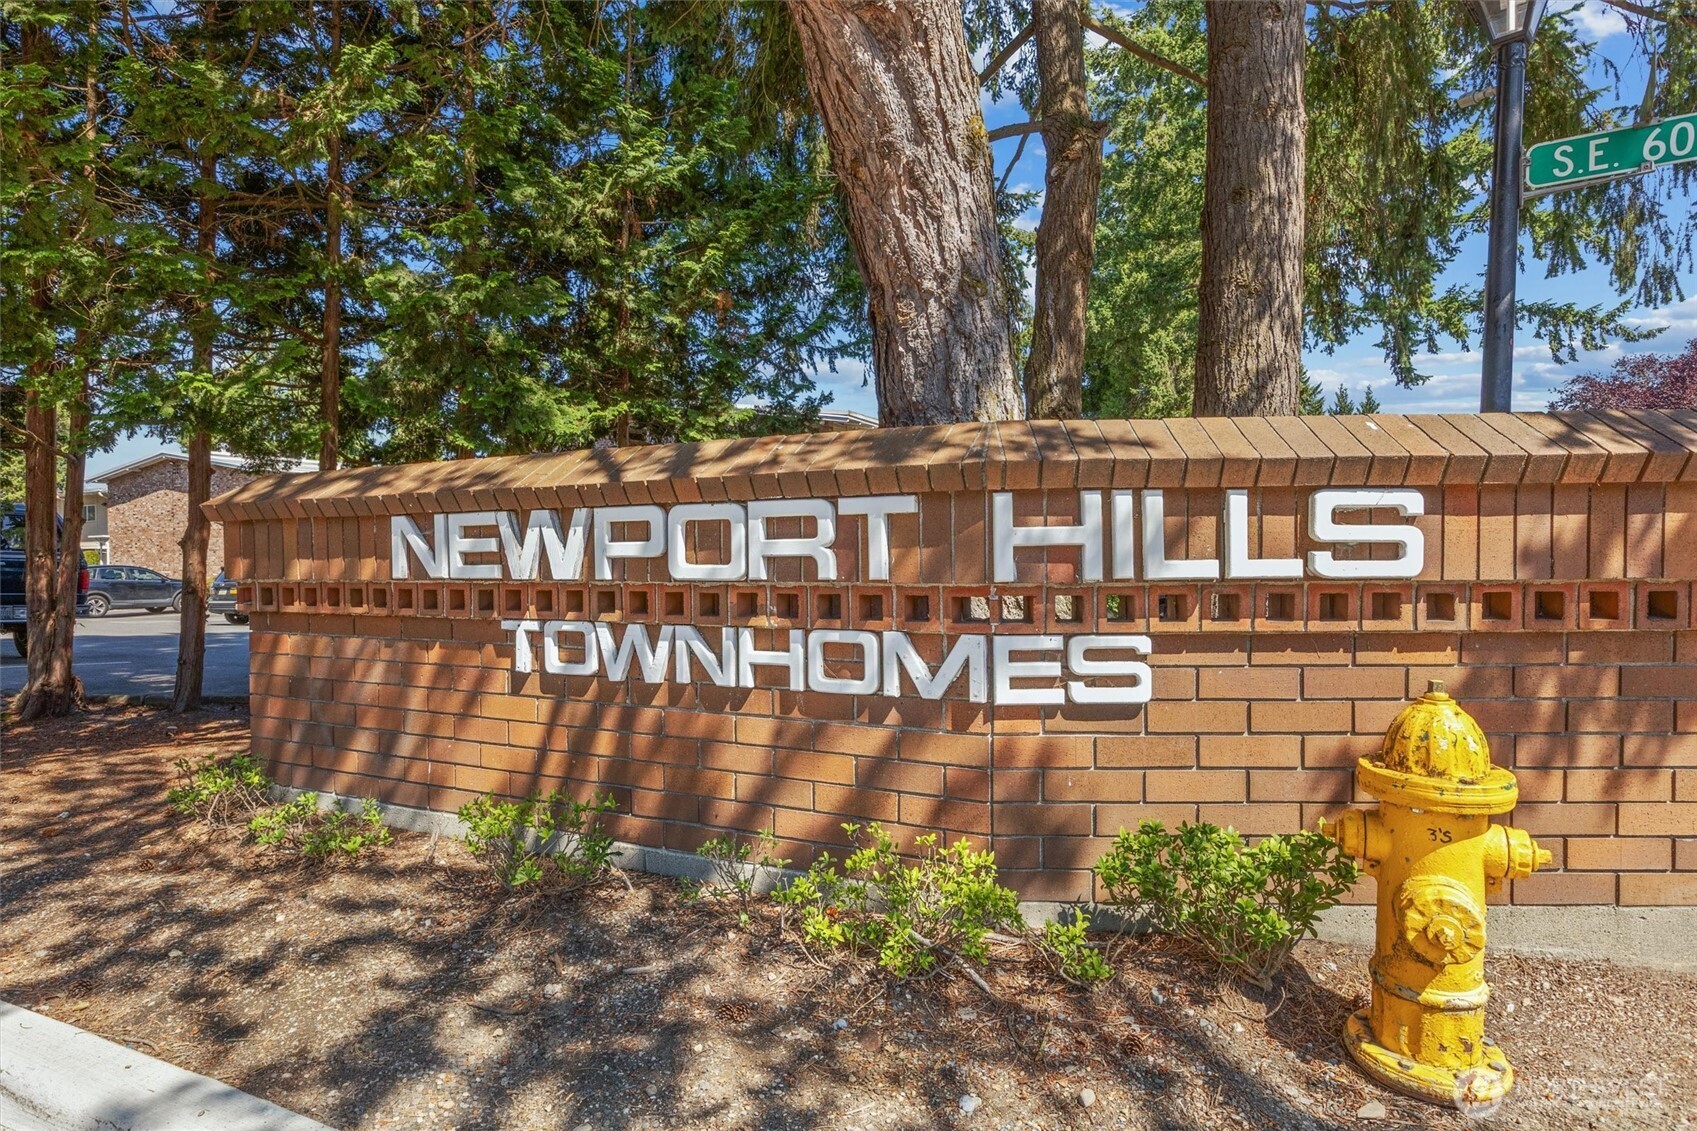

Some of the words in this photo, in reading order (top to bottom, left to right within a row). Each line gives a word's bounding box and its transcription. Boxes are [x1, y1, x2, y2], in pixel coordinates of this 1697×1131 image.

[1552, 137, 1620, 178] S.E.
[1642, 121, 1696, 161] 60
[391, 495, 918, 582] NEWPORT
[993, 489, 1424, 582] HILLS
[501, 619, 1152, 705] TOWNHOMES
